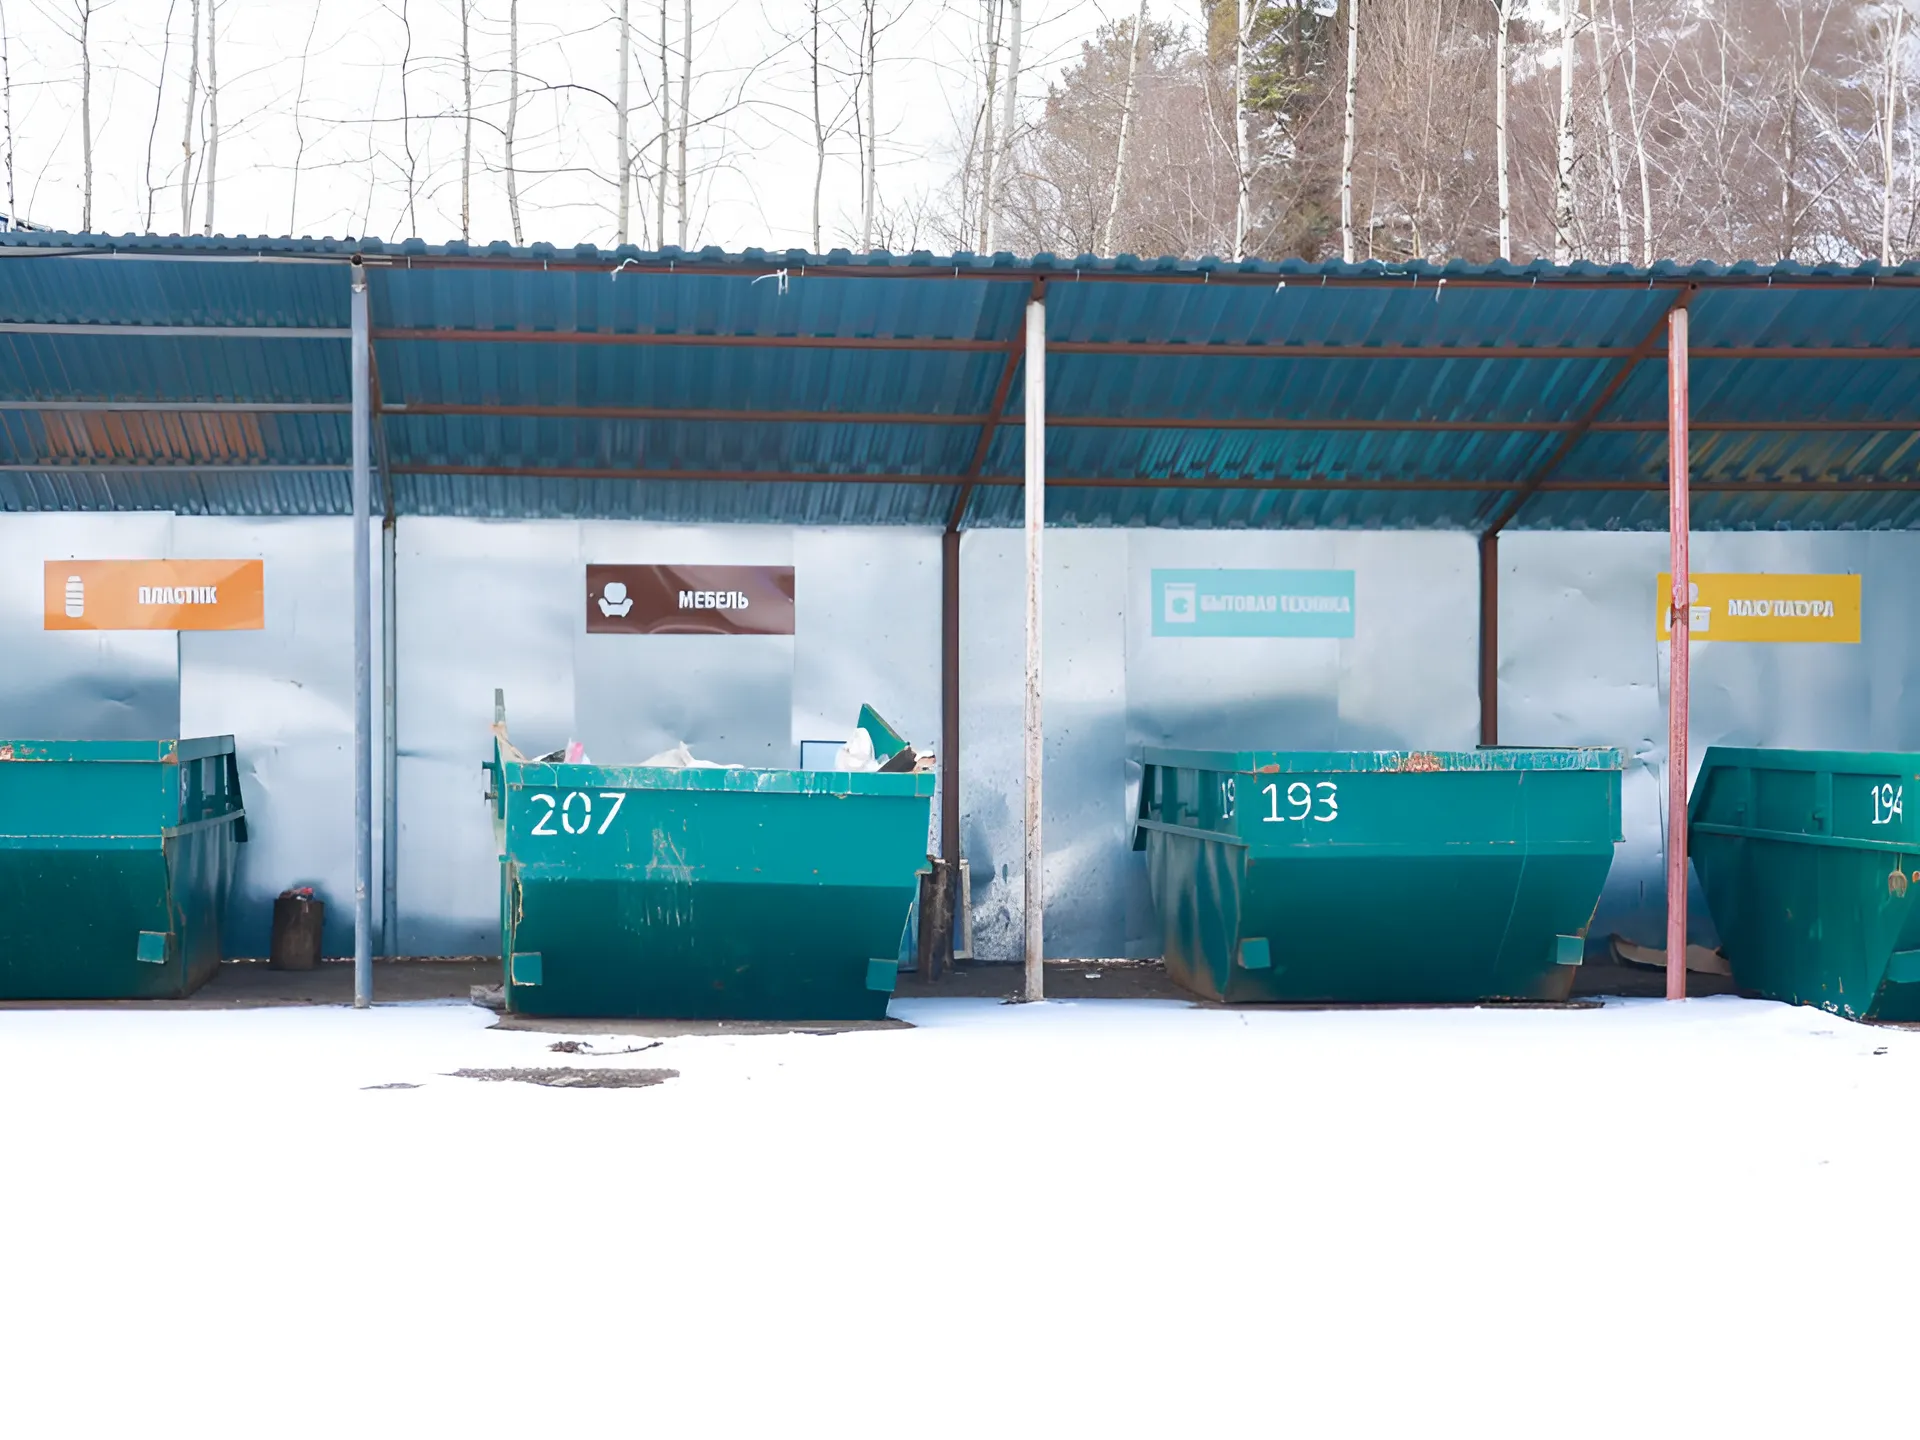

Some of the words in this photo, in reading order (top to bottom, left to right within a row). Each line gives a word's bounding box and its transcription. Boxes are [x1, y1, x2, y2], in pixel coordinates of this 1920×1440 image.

[138, 586, 217, 604] ПЛАСТИК
[678, 590, 749, 609] МЕБЕЛЬ
[530, 791, 626, 836] 207
[1261, 781, 1339, 822] 193
[1870, 782, 1903, 825] 194
